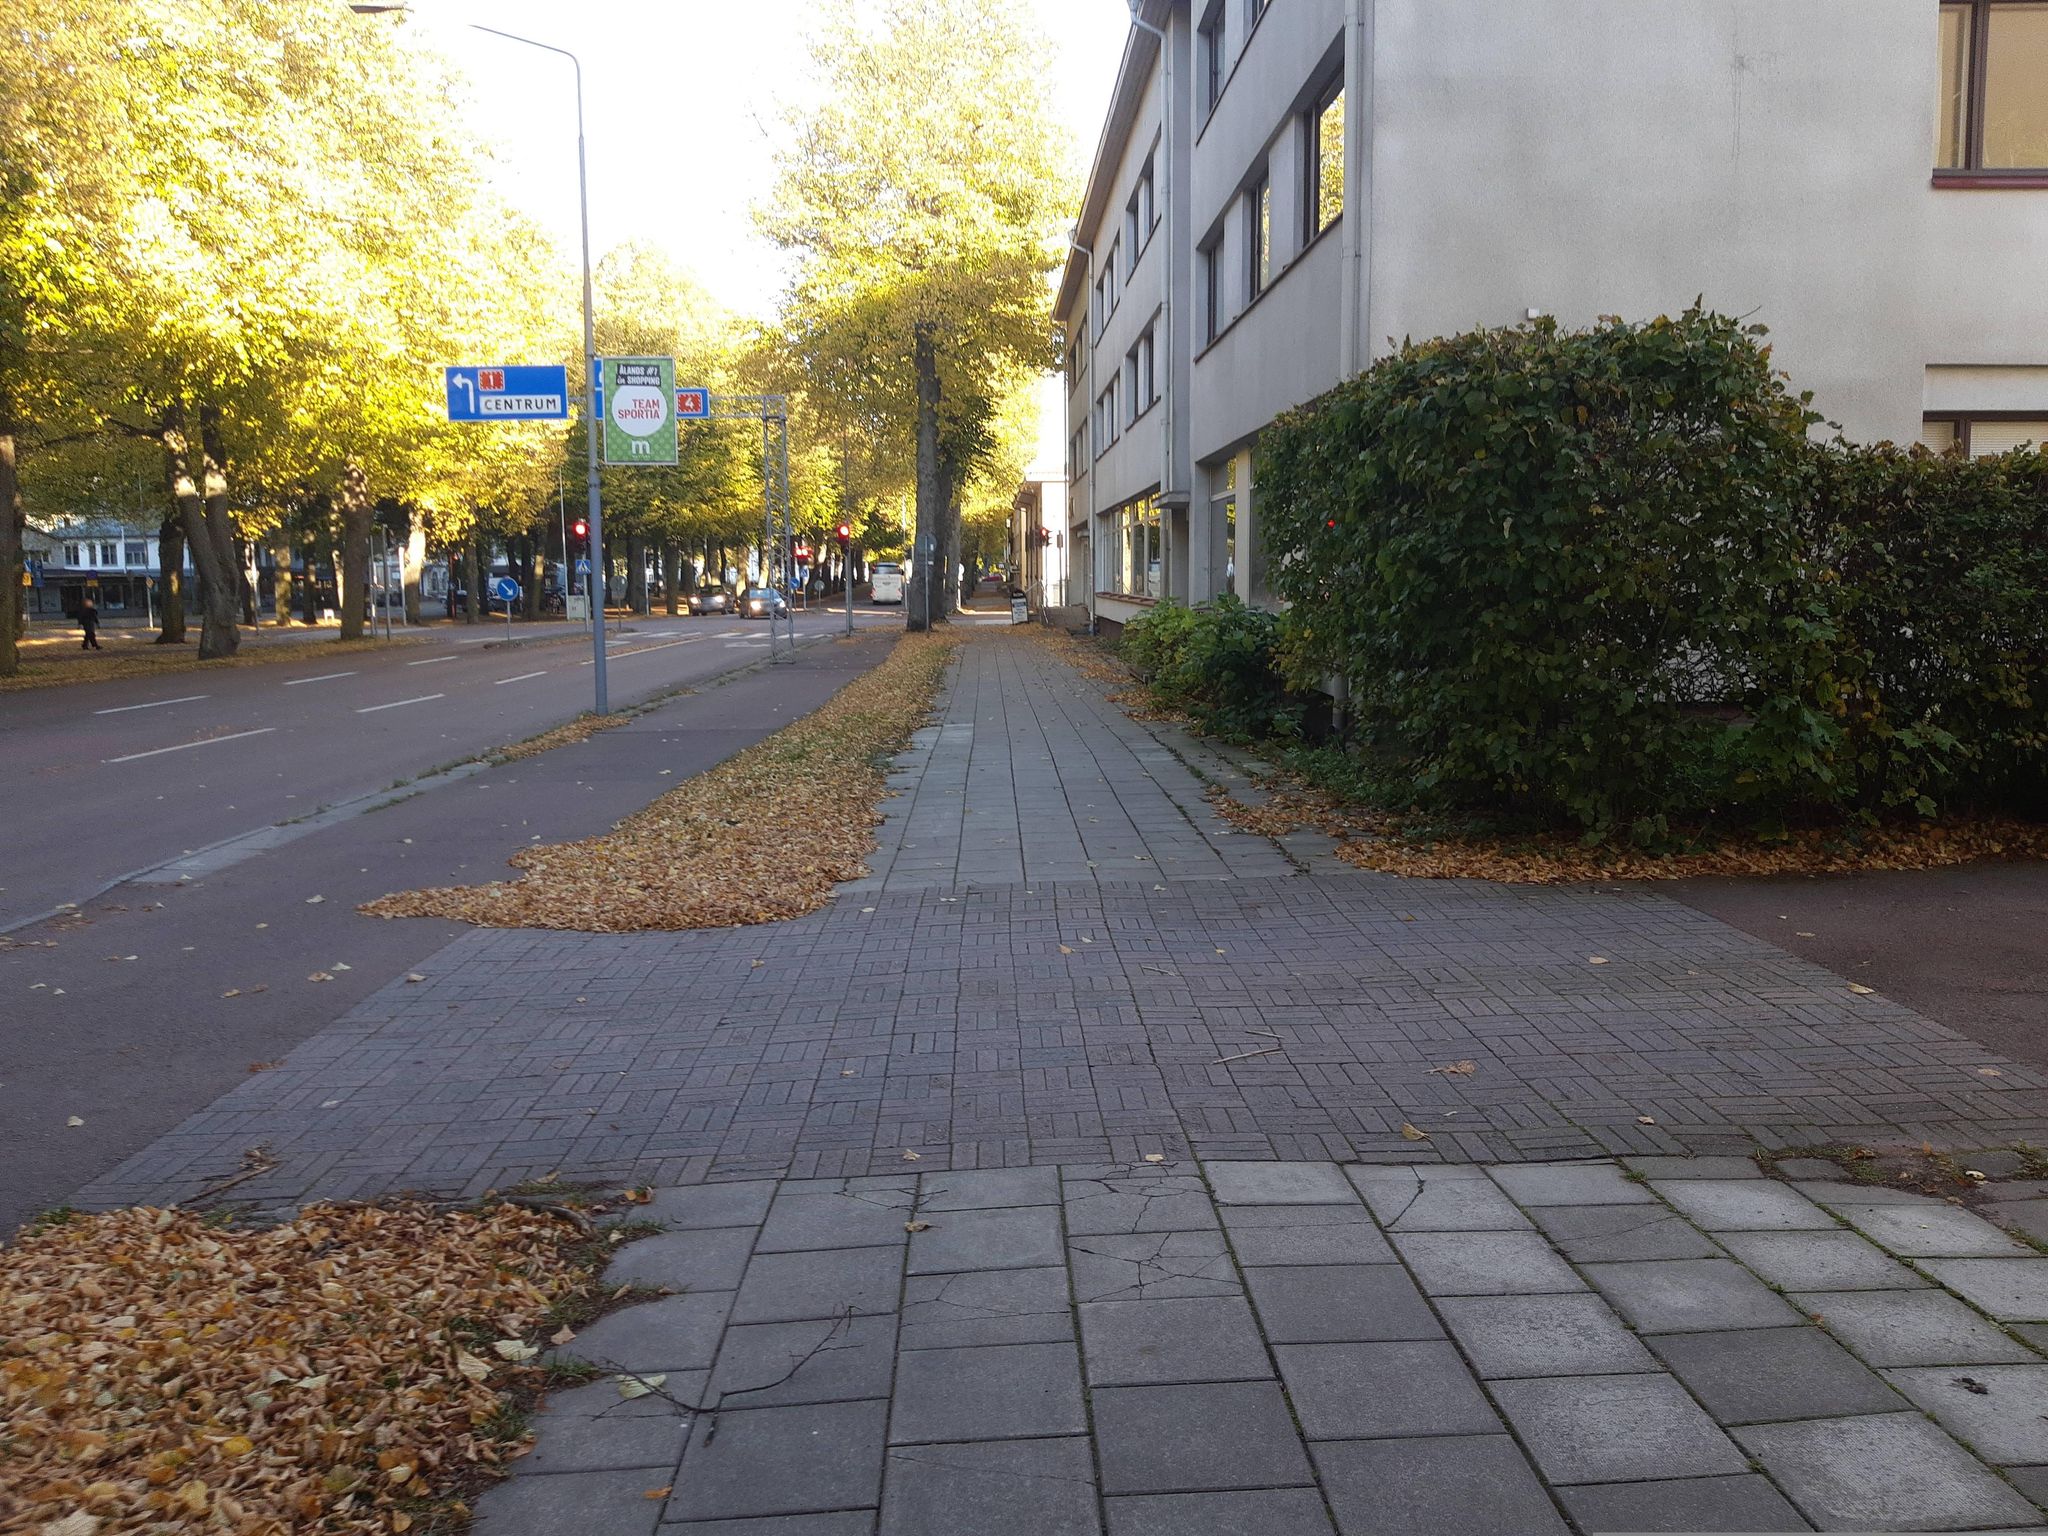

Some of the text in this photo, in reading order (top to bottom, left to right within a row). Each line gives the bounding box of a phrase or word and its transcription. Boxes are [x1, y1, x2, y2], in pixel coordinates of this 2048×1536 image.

[619, 365, 644, 376] ÅLANDS
[627, 376, 660, 385] SHOPPING
[485, 398, 556, 410] CENTRUM
[632, 399, 660, 409] TEAM
[685, 397, 695, 410] 4
[618, 410, 660, 419] SPORTIA
